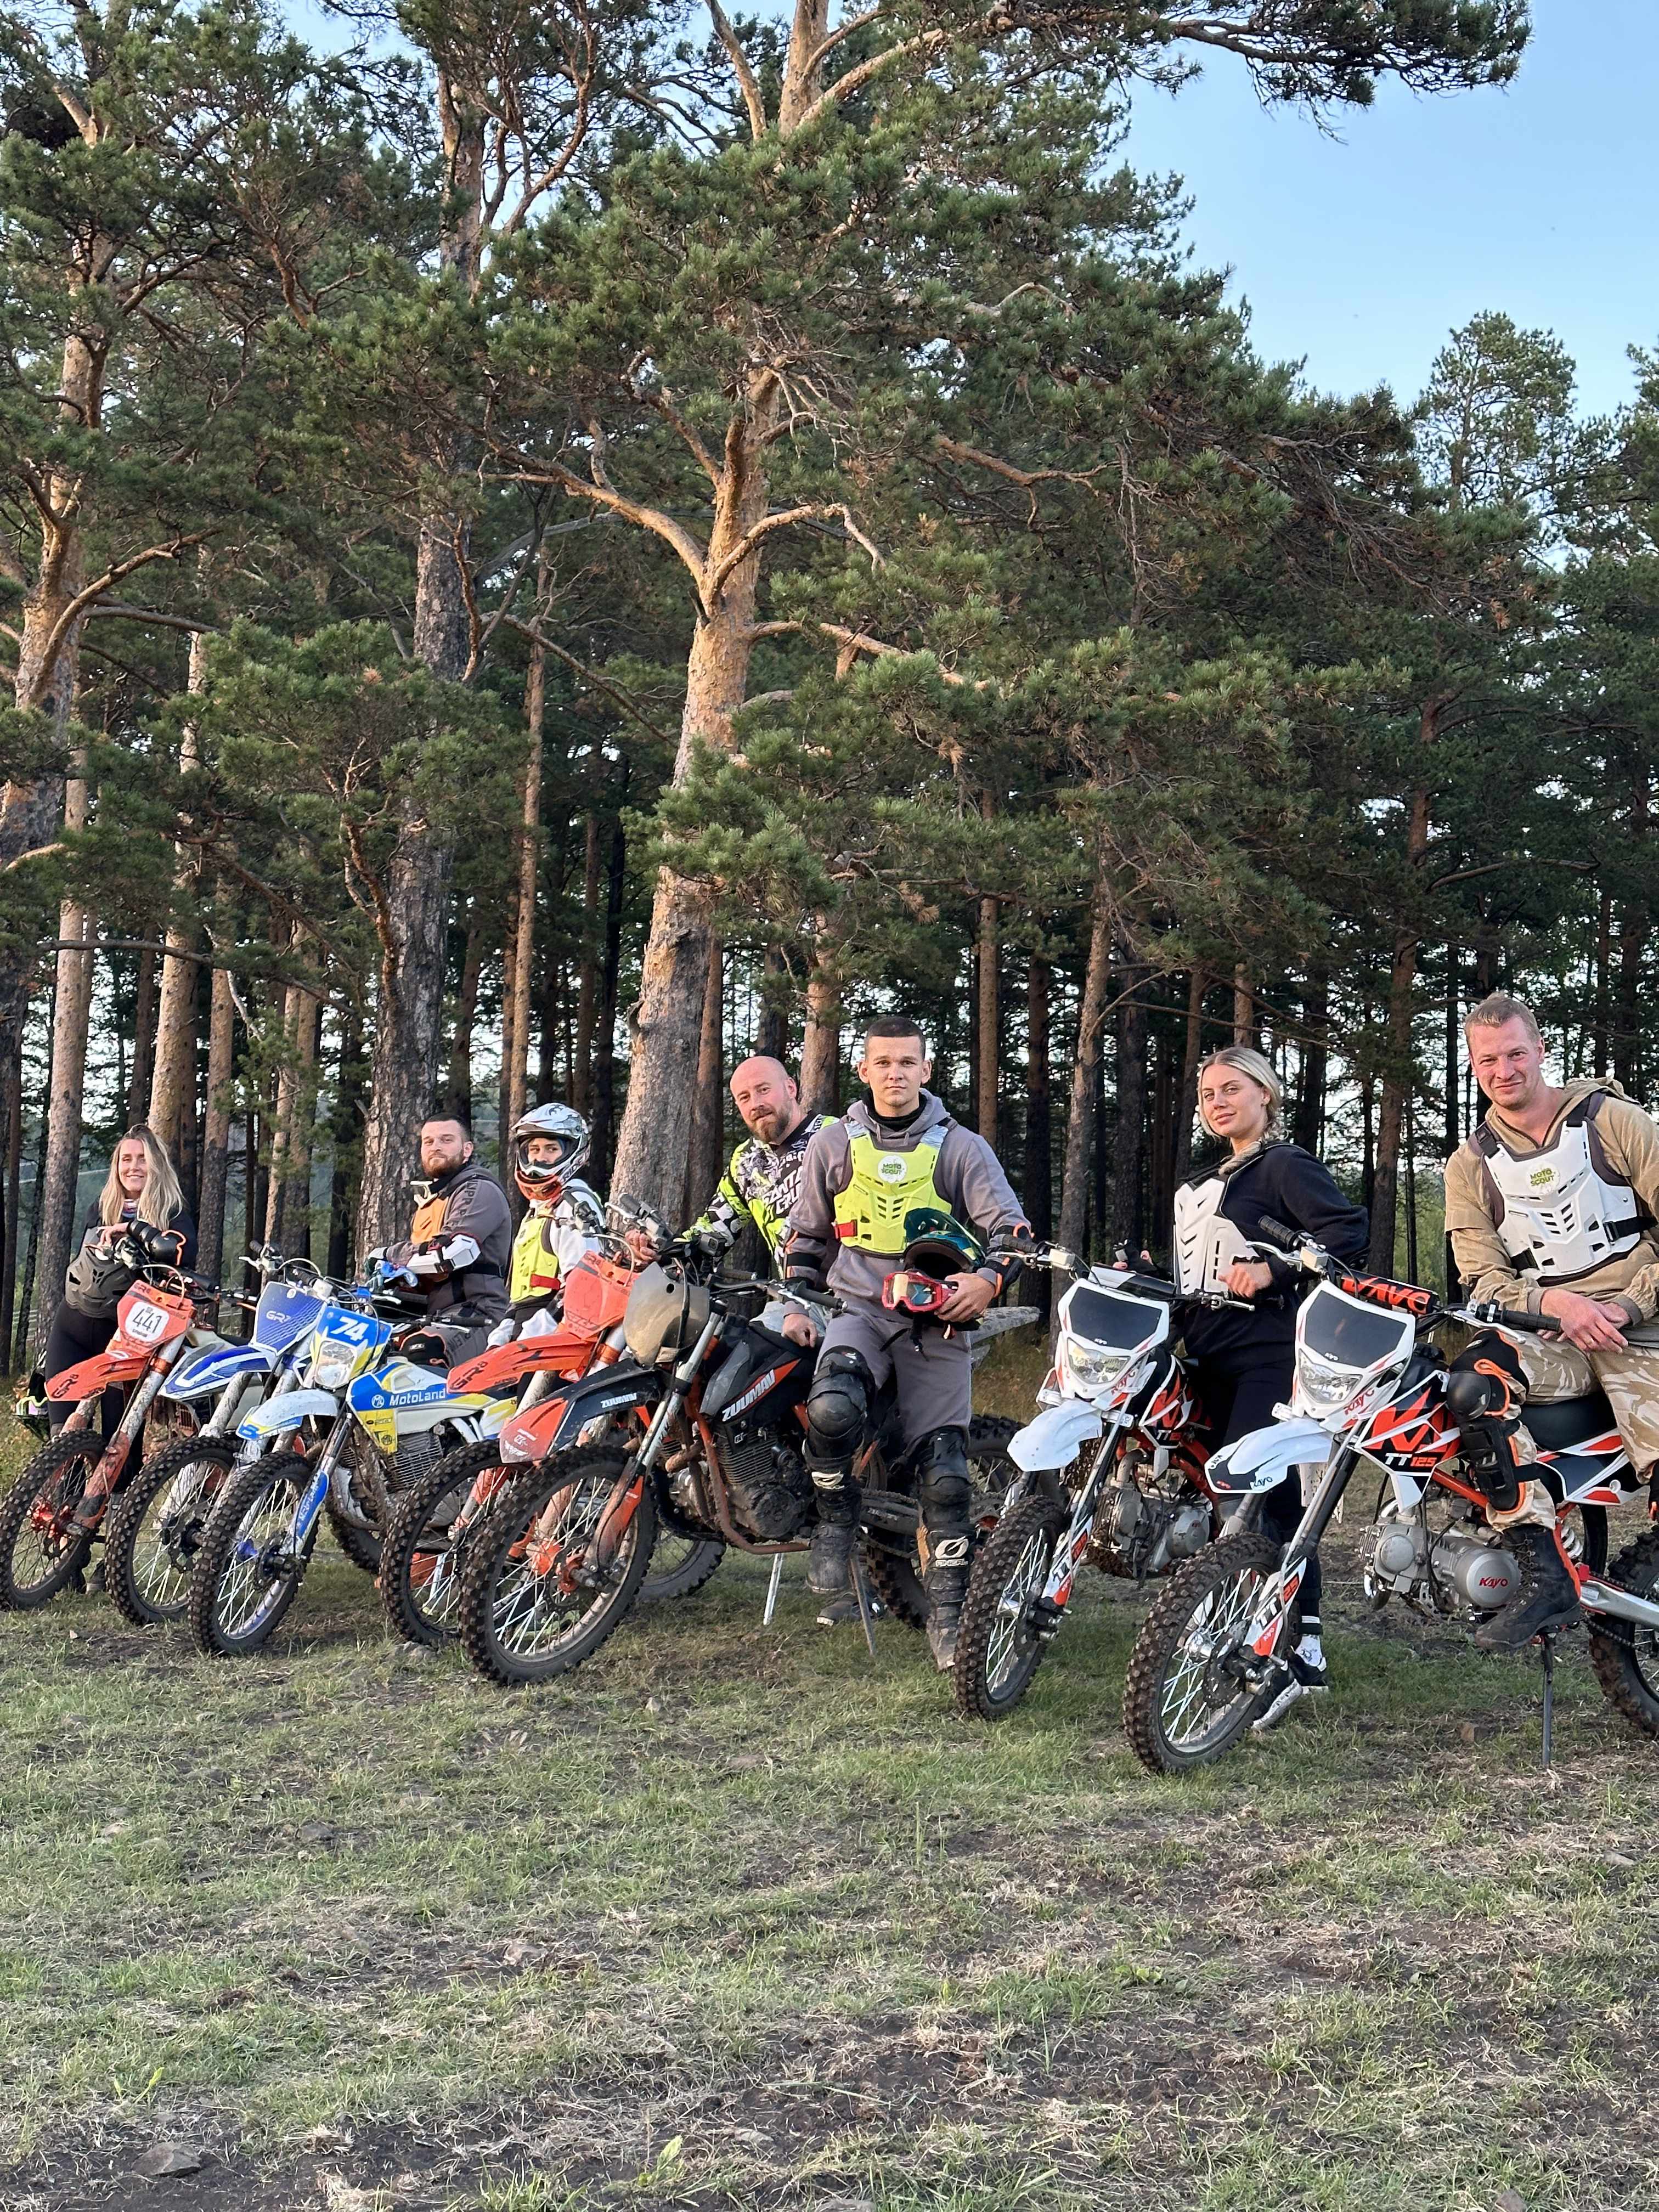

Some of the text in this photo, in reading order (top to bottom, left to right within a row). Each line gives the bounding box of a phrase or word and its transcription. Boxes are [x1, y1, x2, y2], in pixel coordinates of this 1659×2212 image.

[1530, 1168, 1553, 1180] MOTO
[1531, 1175, 1554, 1187] SCOUT
[776, 1183, 800, 1215] CRU
[132, 1308, 162, 1334] 441
[330, 1316, 369, 1341] 74
[52, 1374, 79, 1398] GR8
[450, 1361, 488, 1390] GR8
[721, 1369, 775, 1422] ZUUMAV
[1343, 1387, 1375, 1415] KAYO
[1385, 1453, 1437, 1467] TT 125
[1479, 1576, 1508, 1589] KAYO
[1256, 1573, 1300, 1627] TT 25
